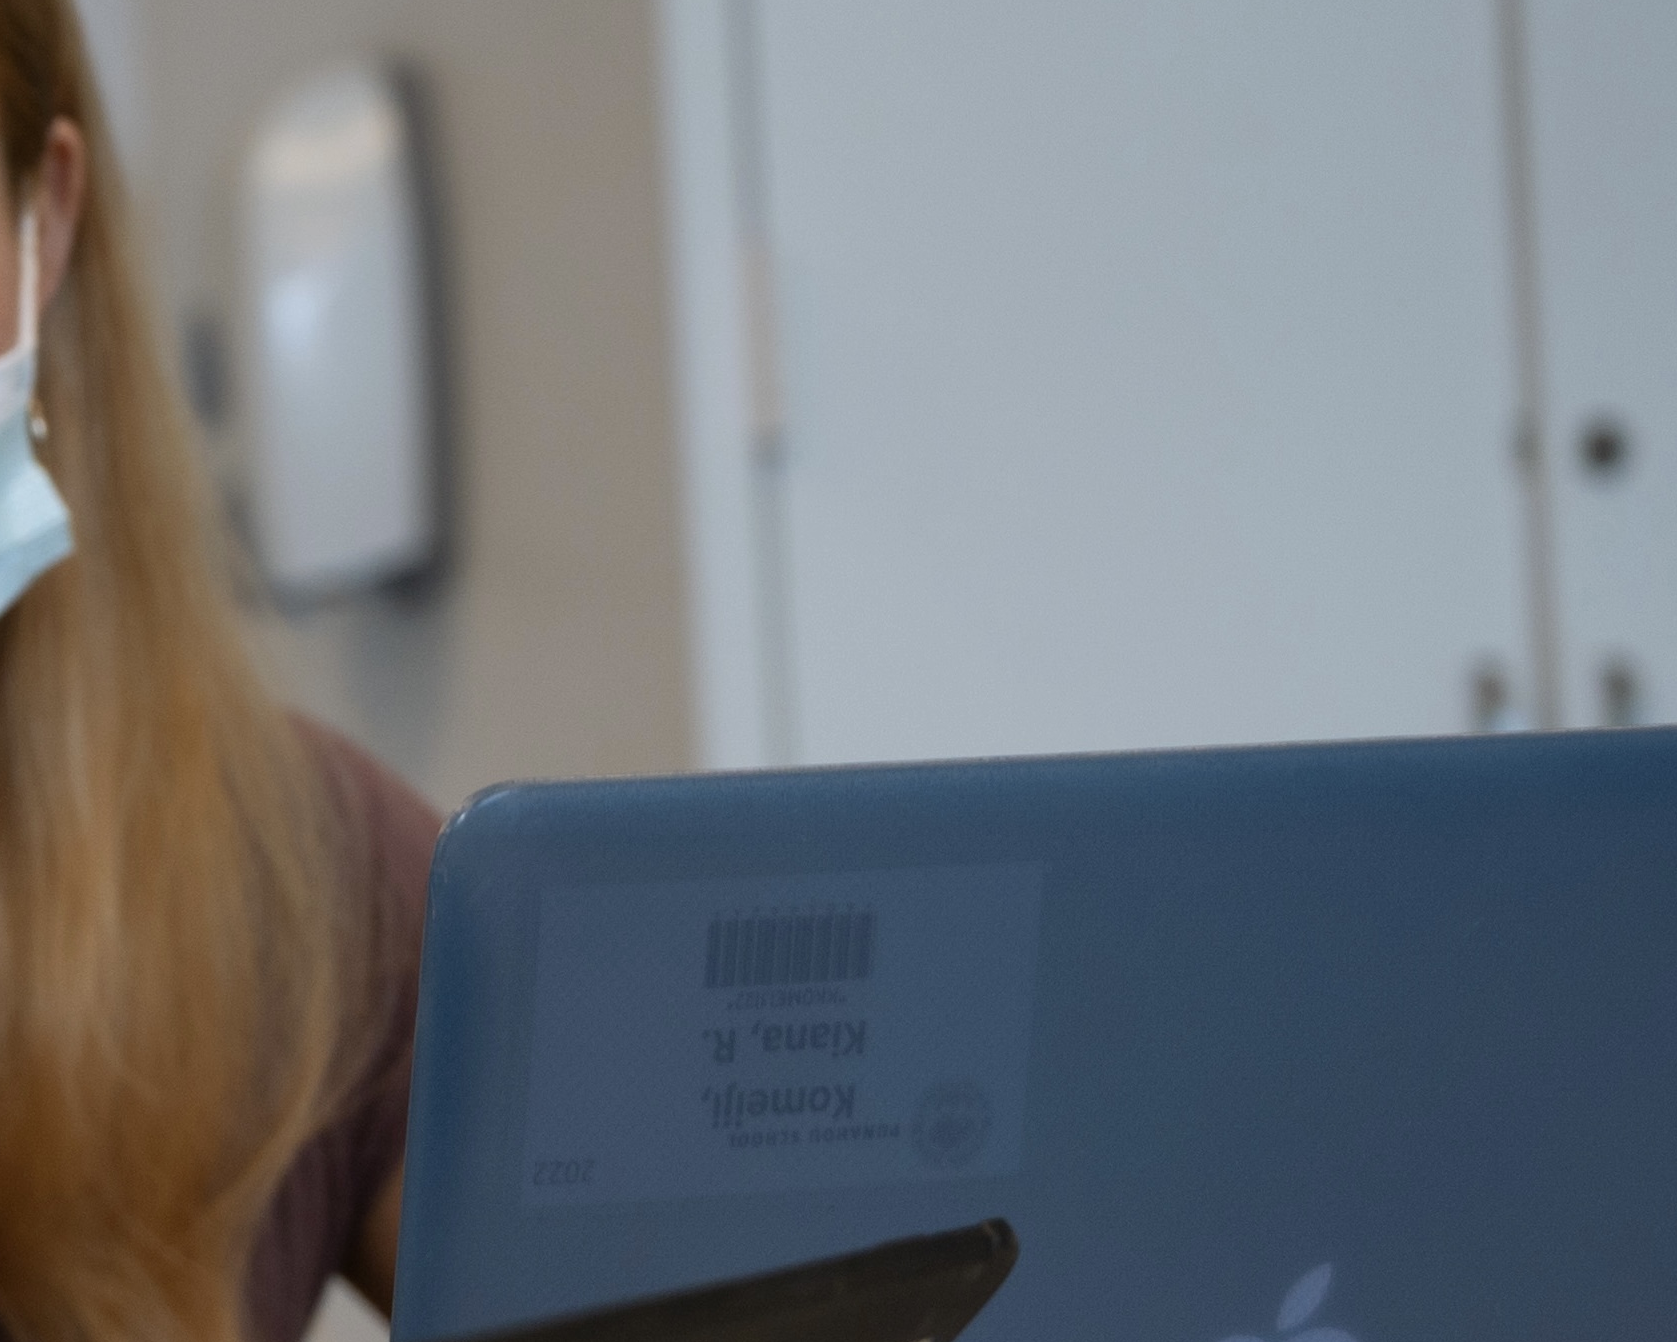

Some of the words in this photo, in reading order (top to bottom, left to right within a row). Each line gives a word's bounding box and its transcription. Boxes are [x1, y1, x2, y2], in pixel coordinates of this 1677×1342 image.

[702, 1028, 738, 1064] R.
[751, 1019, 868, 1060] Kiana,
[700, 1082, 857, 1129] Komeiji,
[727, 1128, 800, 1149] SCHOOL
[809, 1122, 901, 1146] PUNAHOU
[532, 1157, 596, 1187] 2022
